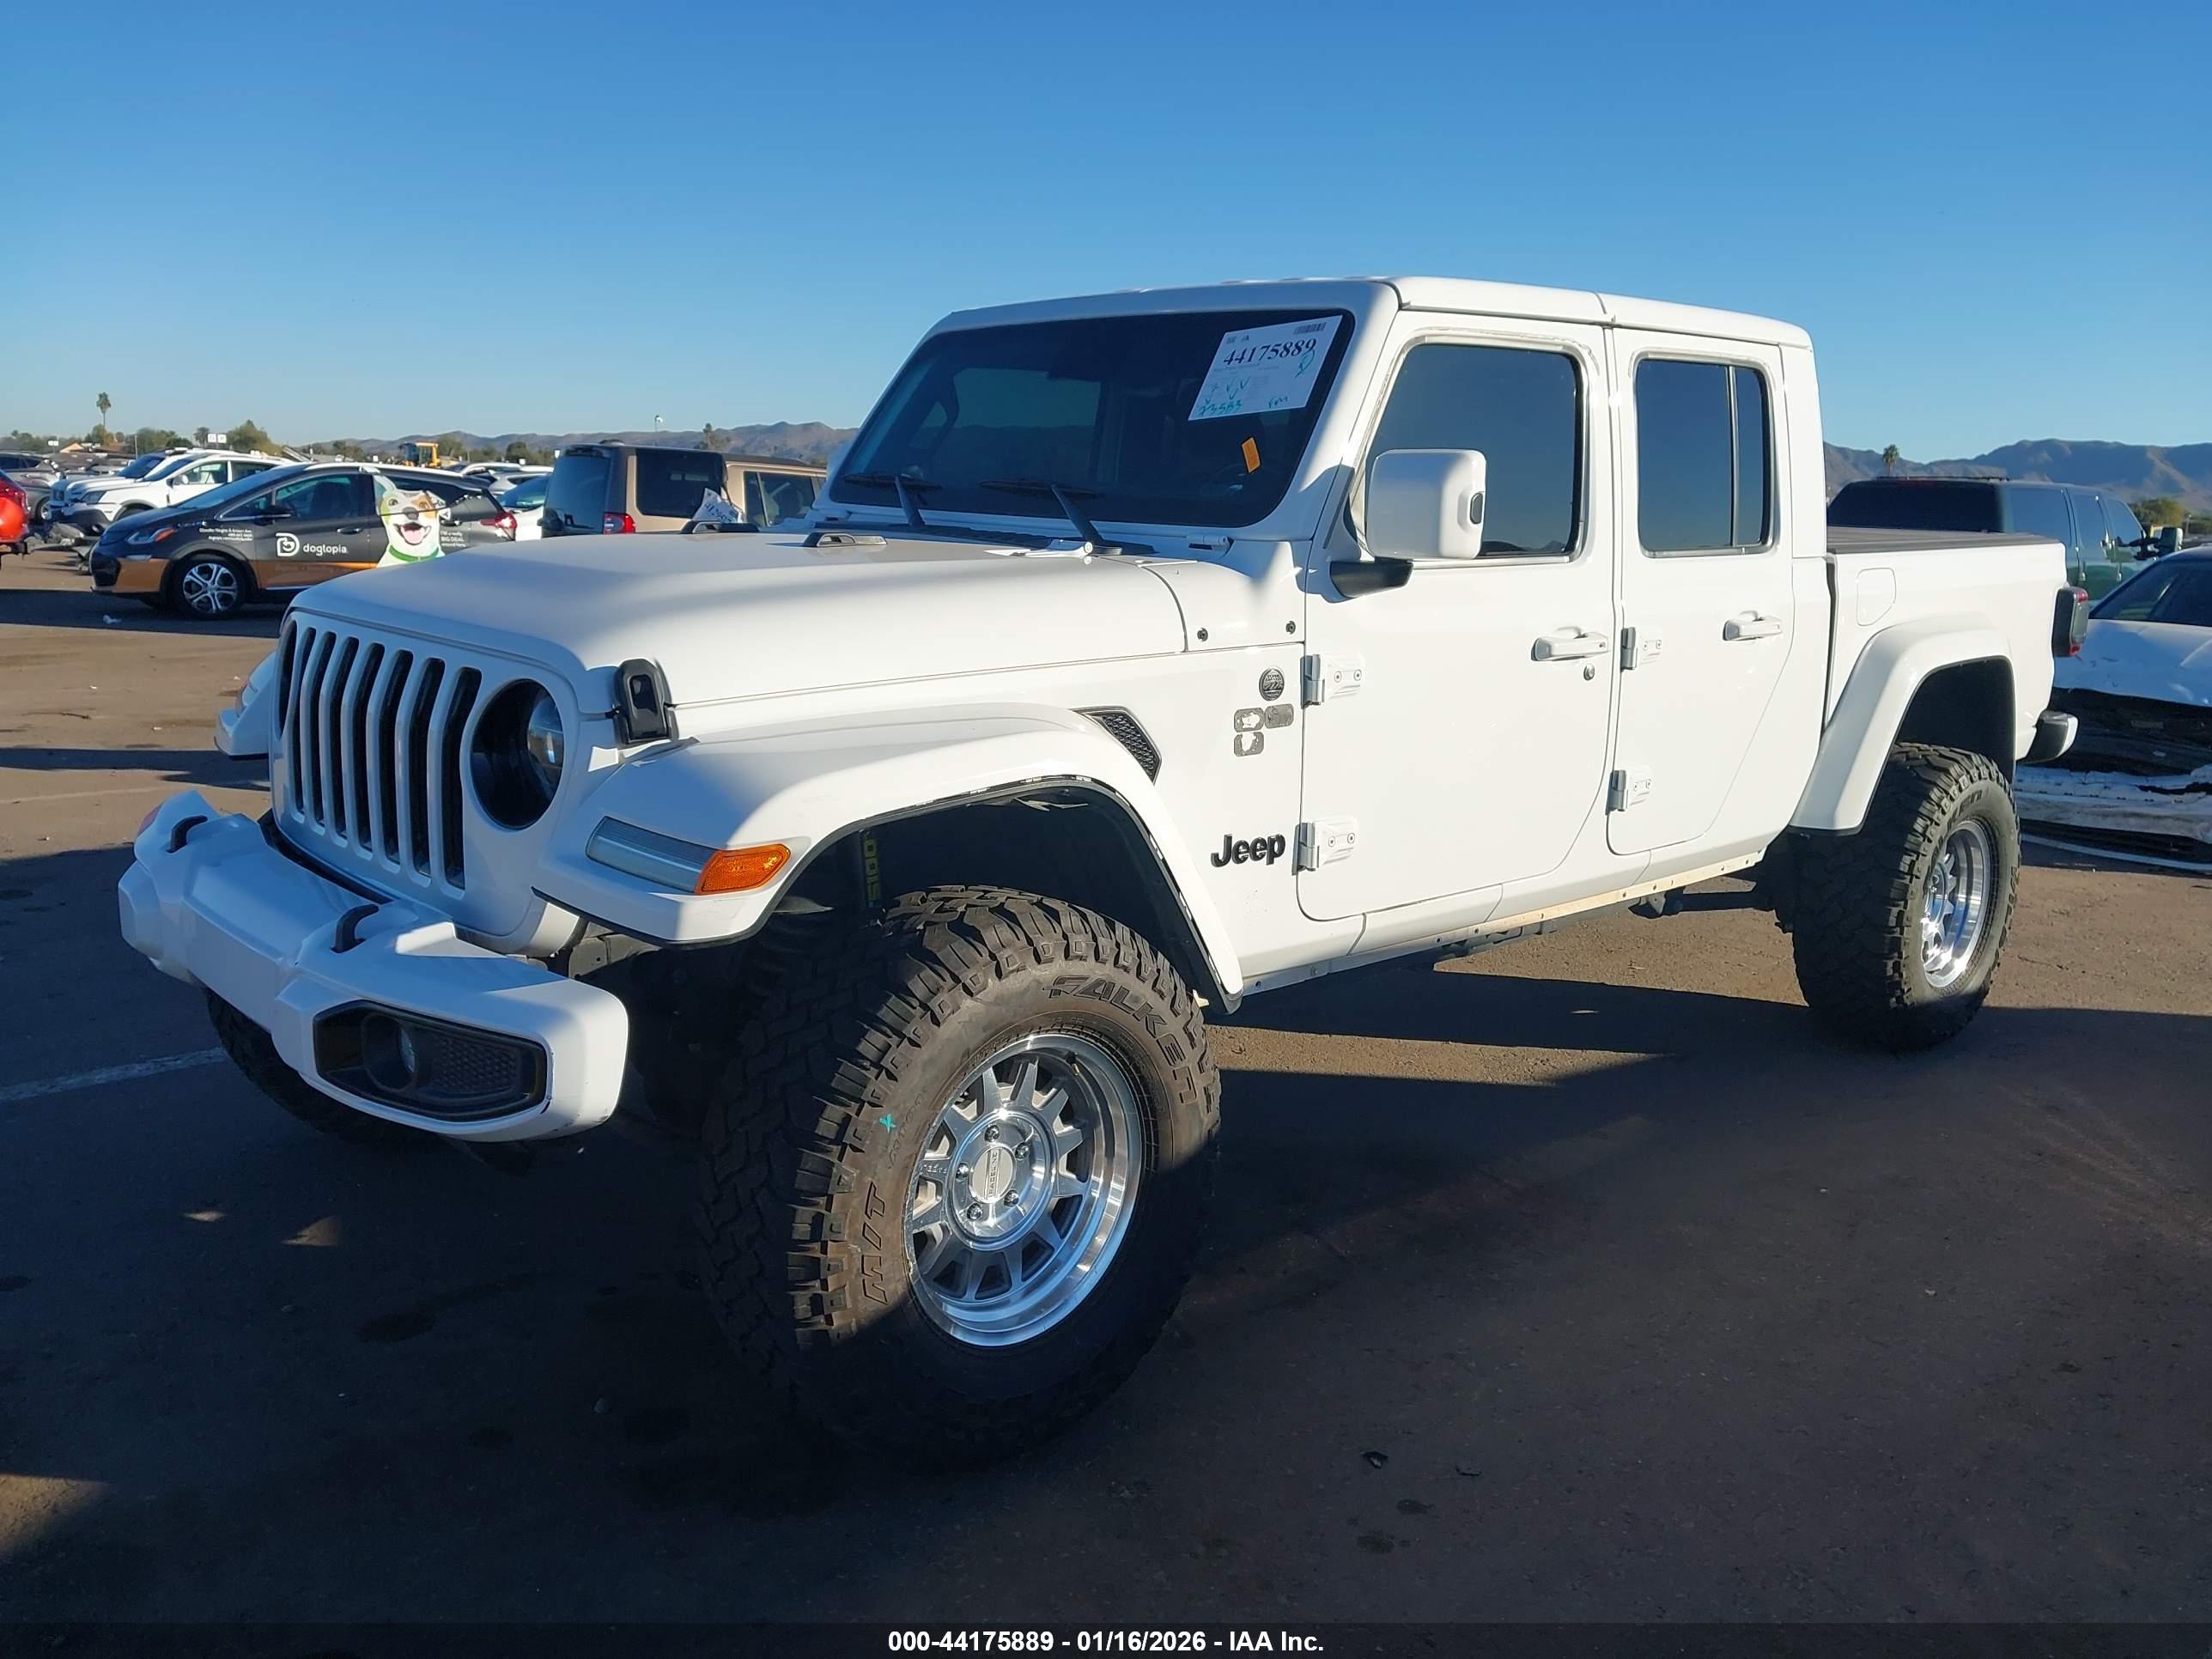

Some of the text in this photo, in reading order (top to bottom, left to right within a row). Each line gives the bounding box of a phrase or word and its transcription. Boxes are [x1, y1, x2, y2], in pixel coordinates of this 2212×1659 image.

[1223, 337, 1317, 365] 44175889
[303, 543, 347, 556] dogtopia
[1211, 834, 1286, 867] Jeep
[1042, 975, 1198, 1104] FALKEN
